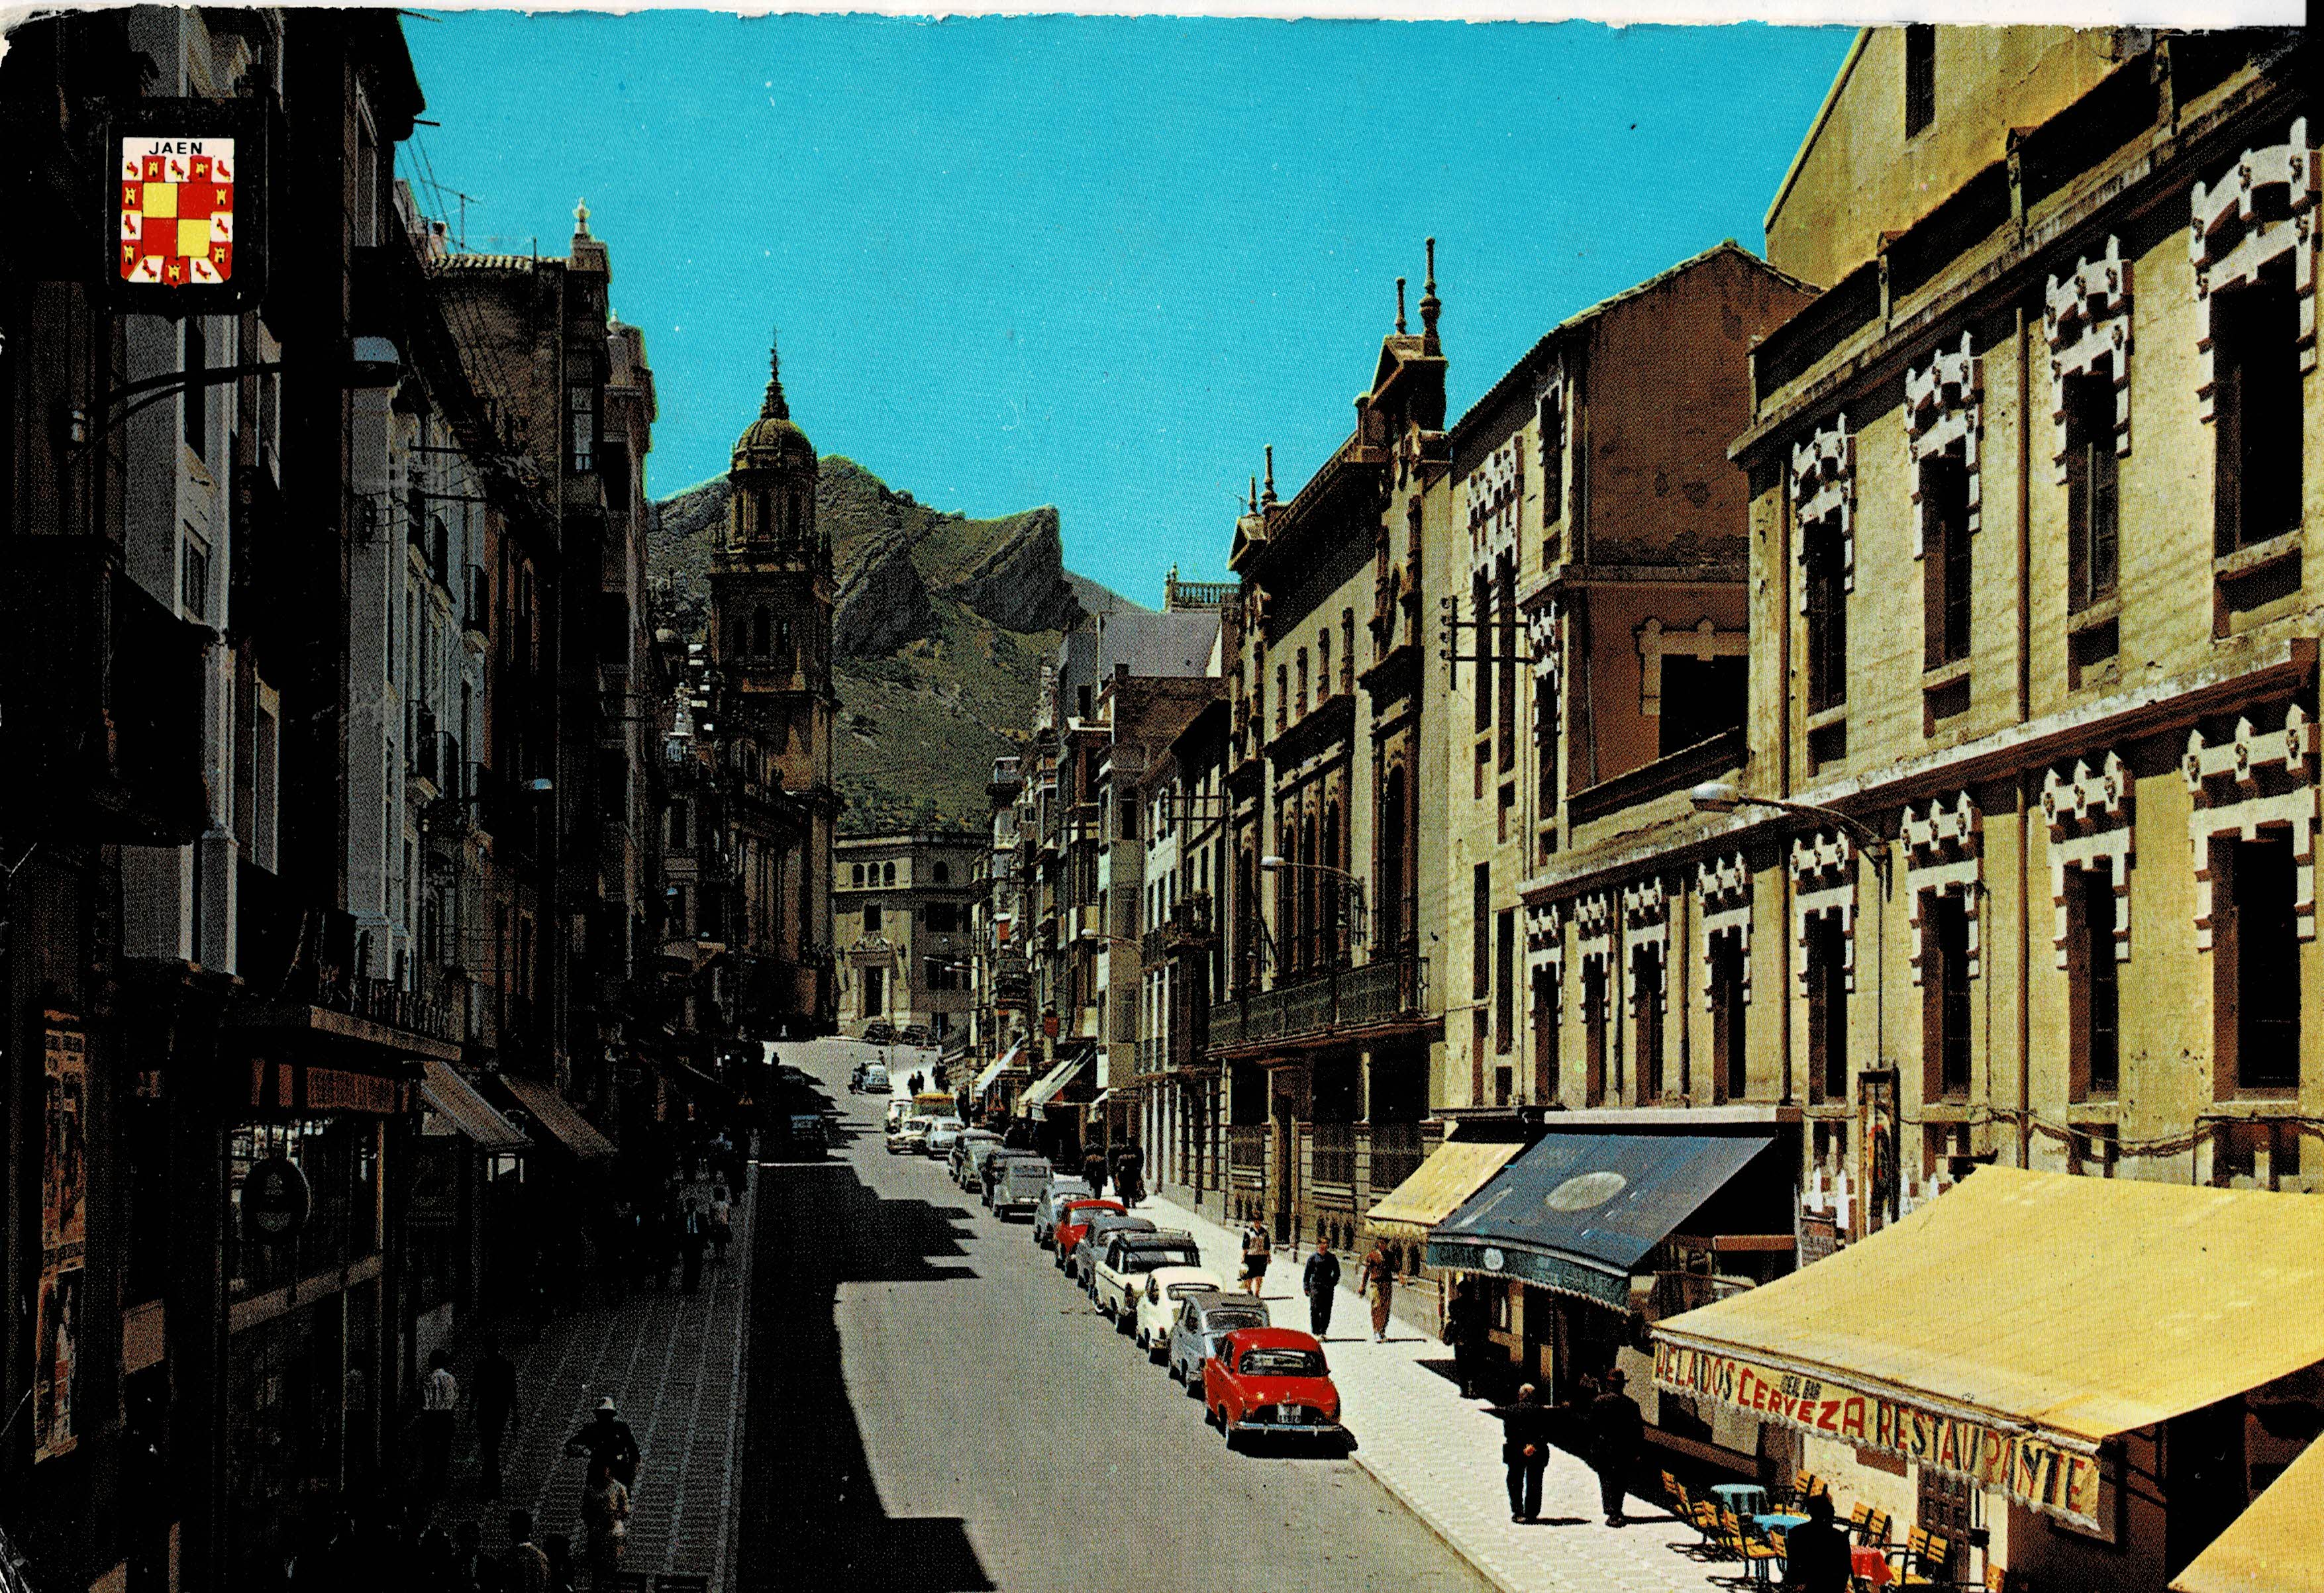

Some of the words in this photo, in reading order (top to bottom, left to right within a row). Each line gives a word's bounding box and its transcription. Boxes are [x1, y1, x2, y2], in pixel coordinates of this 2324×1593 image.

[1655, 1342, 1735, 1401] HELADOS
[1737, 1367, 1866, 1438] CERVEZA
[1876, 1400, 2086, 1513] RESTAURANTE
